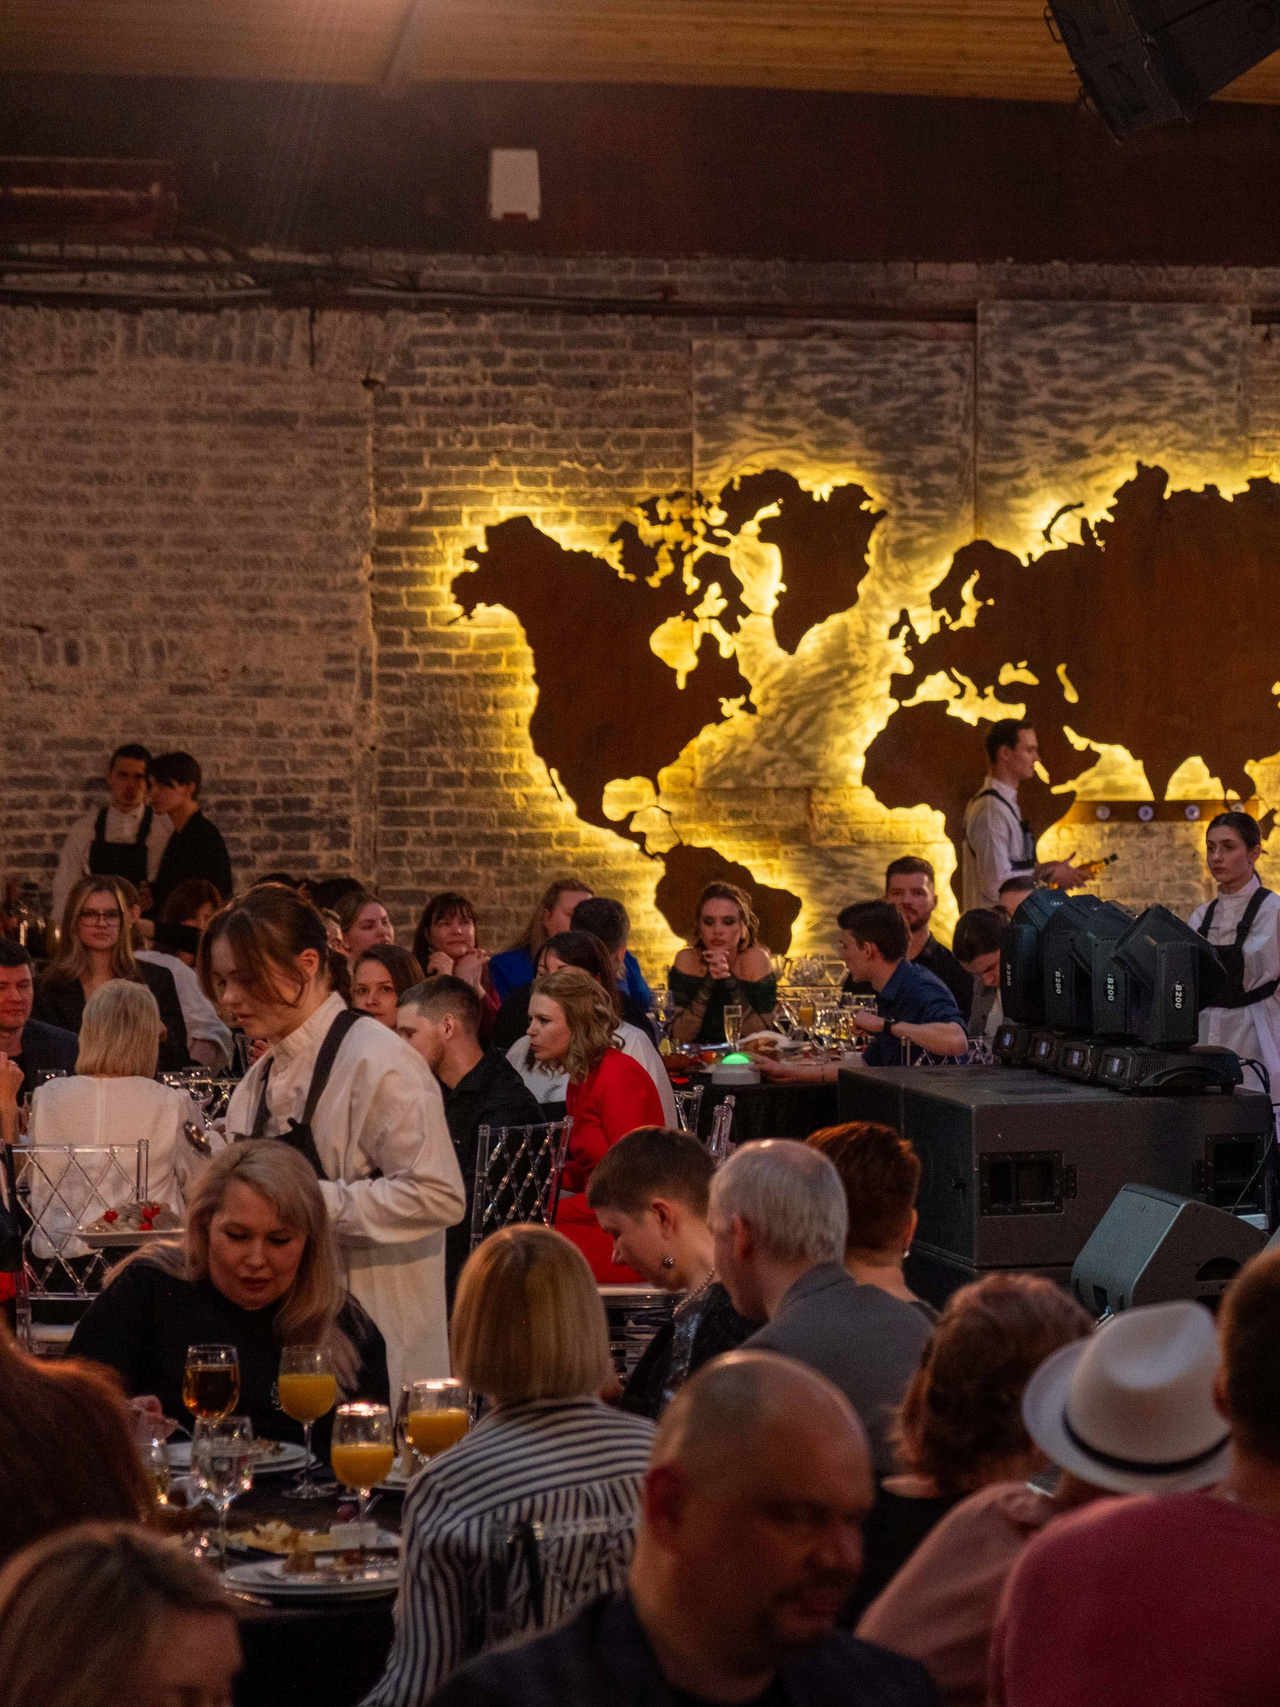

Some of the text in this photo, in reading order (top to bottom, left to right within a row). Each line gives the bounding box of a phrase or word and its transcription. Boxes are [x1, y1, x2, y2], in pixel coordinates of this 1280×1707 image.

[1054, 970, 1062, 995] B200
[1107, 977, 1115, 1002] B200
[1174, 984, 1183, 1009] B200
